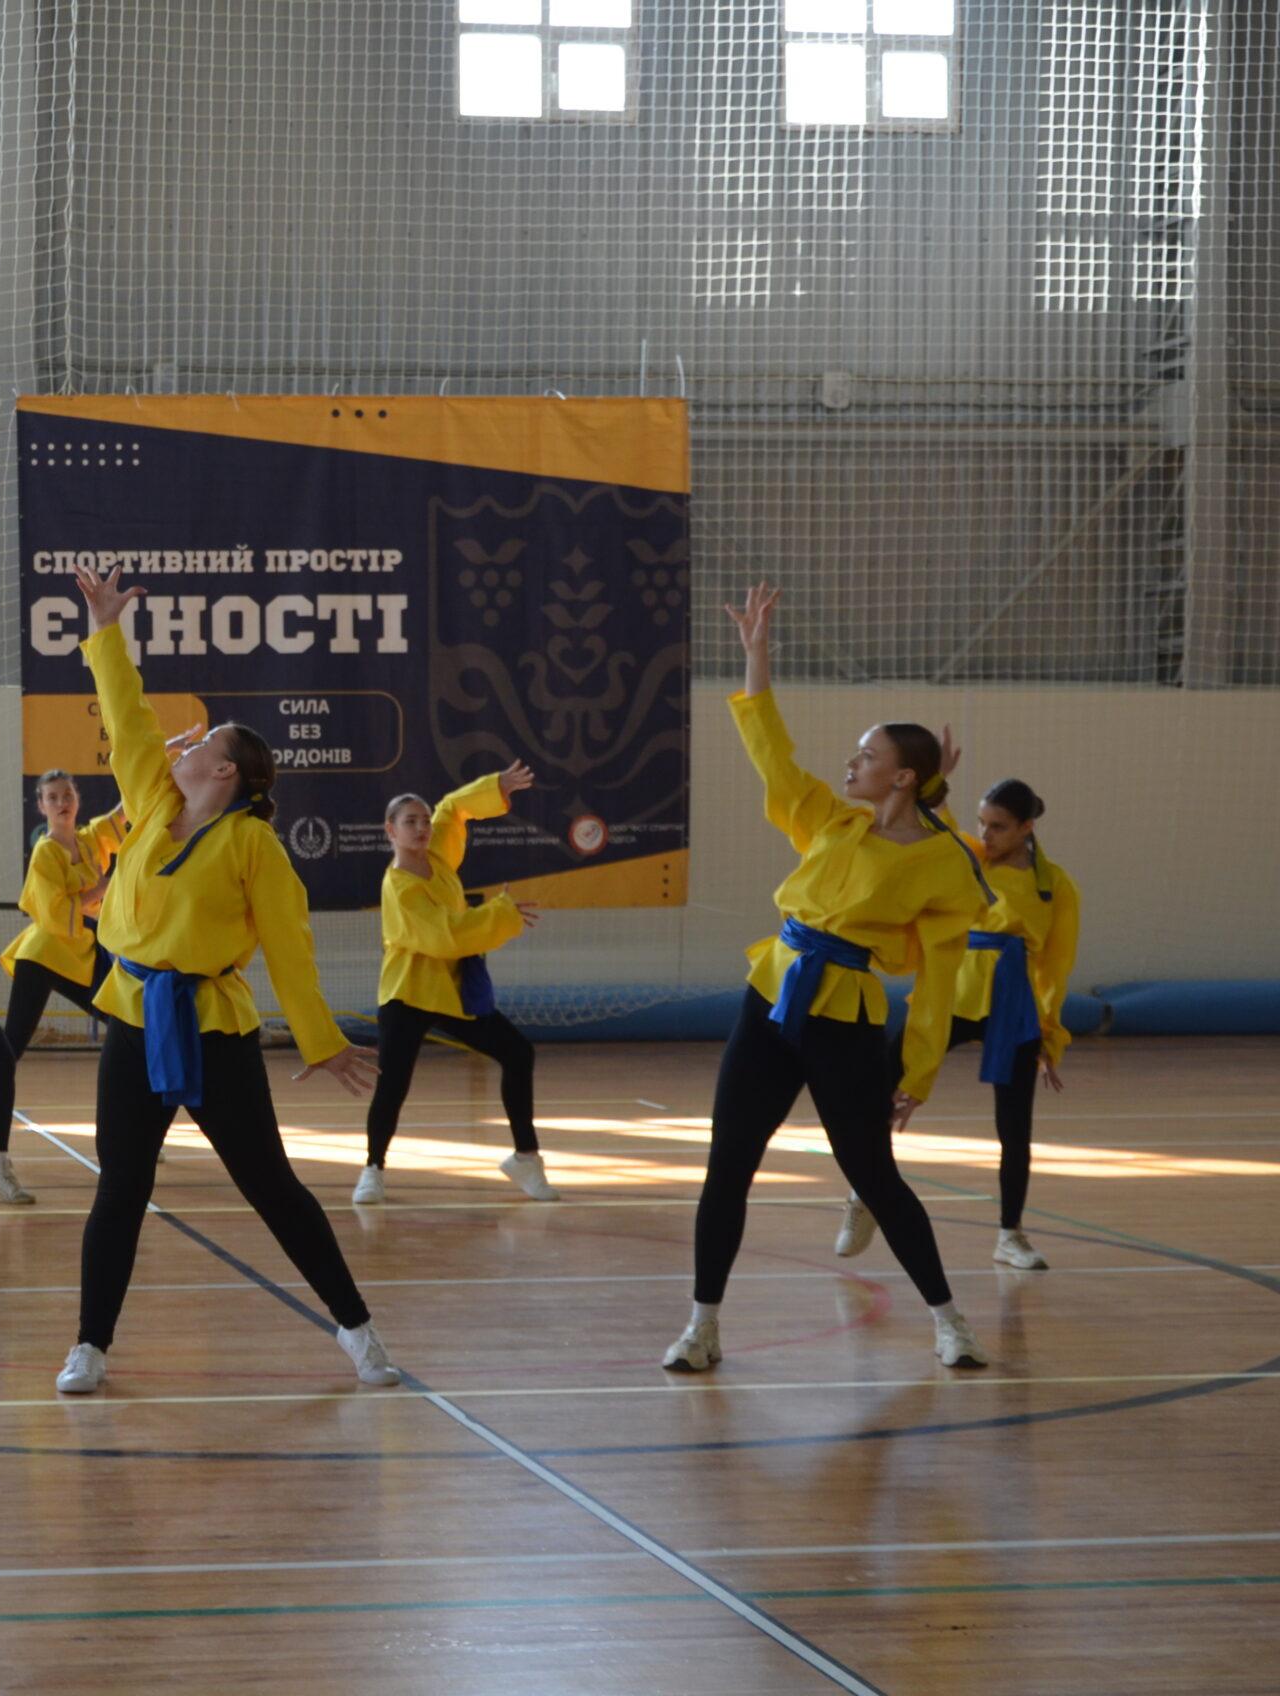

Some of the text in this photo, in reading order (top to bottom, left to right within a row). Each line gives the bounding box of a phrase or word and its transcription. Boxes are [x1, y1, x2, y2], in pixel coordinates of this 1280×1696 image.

[33, 544, 403, 574] СПОРТИВНИЙ ПРОСТІР
[279, 699, 330, 715] СИЛА
[289, 724, 322, 740] БЕЗ
[271, 748, 352, 768] ОРДОНІВ
